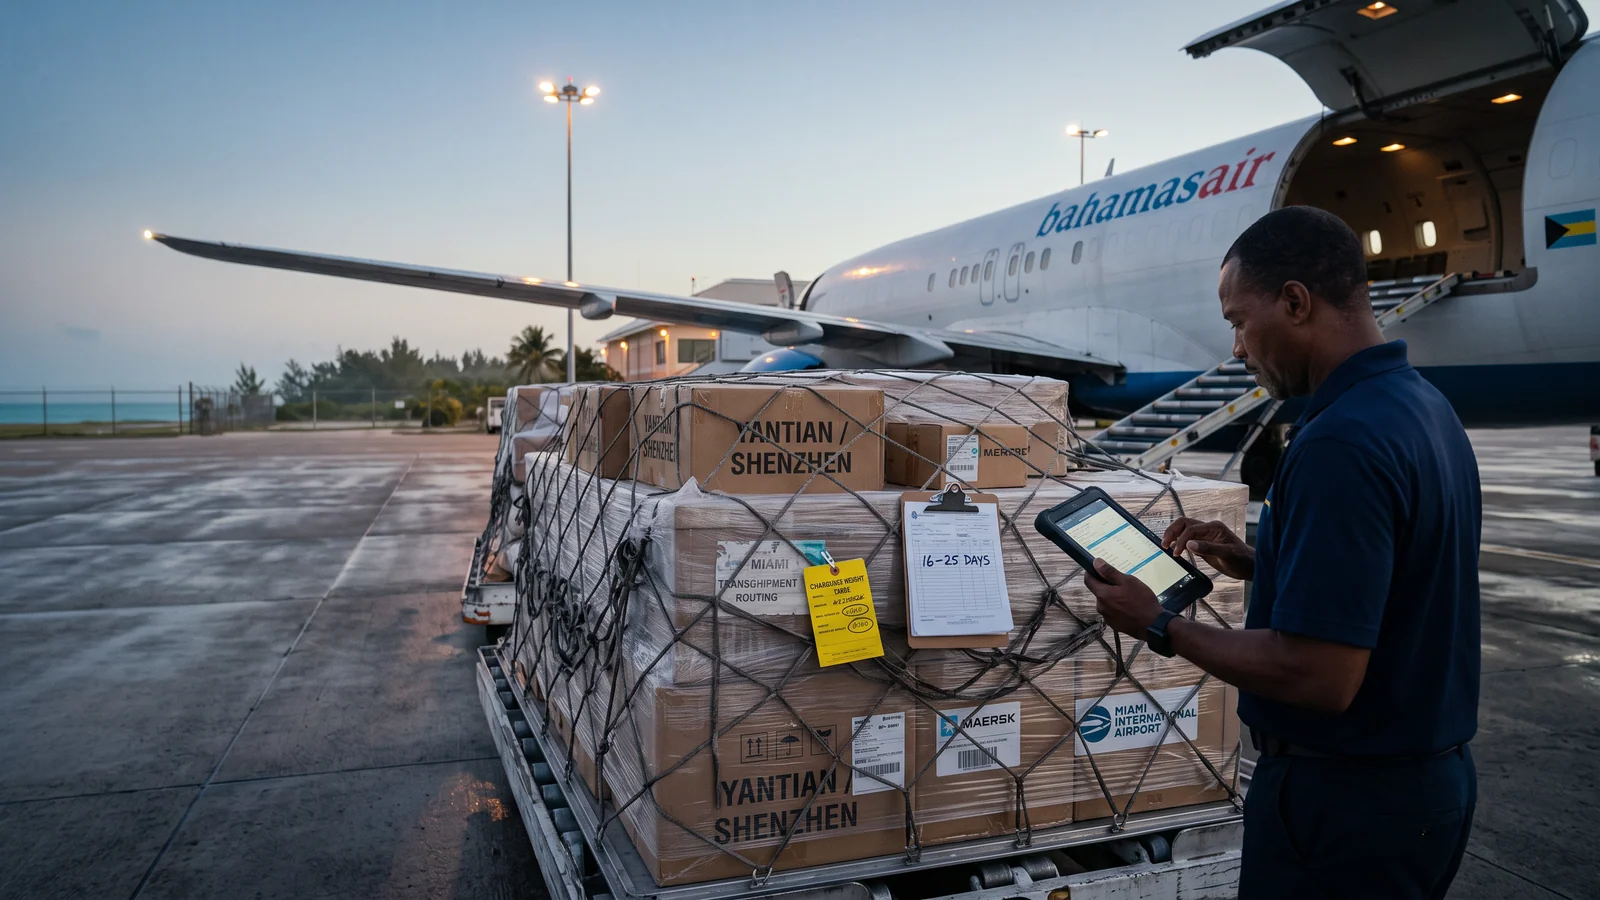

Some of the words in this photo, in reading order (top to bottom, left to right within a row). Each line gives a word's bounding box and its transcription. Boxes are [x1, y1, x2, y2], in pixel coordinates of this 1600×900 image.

[1036, 148, 1276, 237] bahamasair
[735, 421, 832, 444] YANTIAN
[643, 440, 676, 462] SHENZHE
[731, 451, 852, 475] SHENZHEN
[751, 559, 789, 570] MIAMI
[922, 554, 959, 567] 16-25
[964, 554, 991, 568] DAYS
[735, 593, 778, 603] ROUTING
[1115, 703, 1147, 716] MIAMI
[962, 713, 1016, 729] MAERSK
[1114, 723, 1161, 738] AIRPORT
[721, 768, 837, 807] YANTIAN
[714, 801, 858, 845] SHENZHEN
